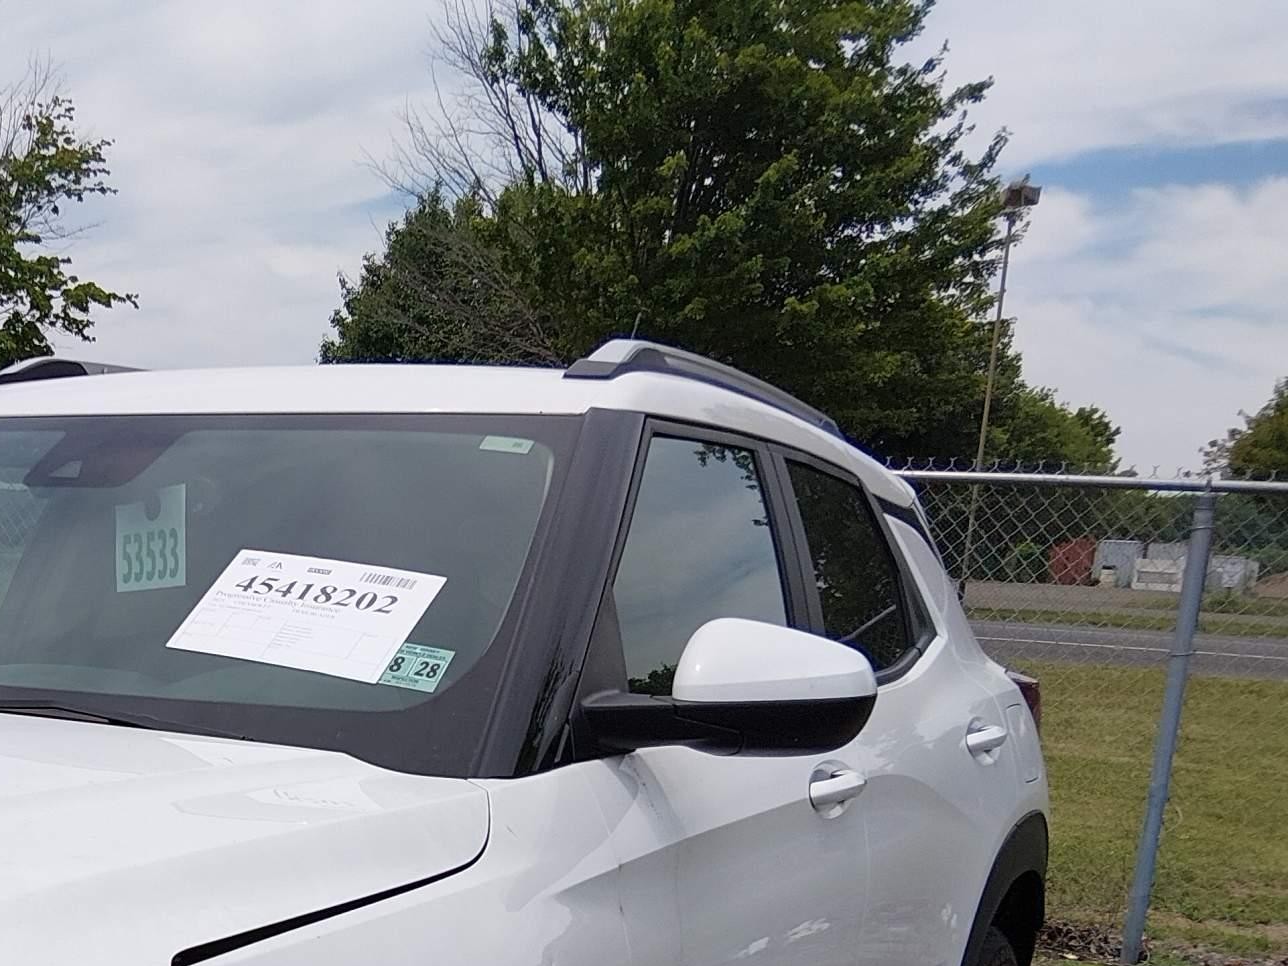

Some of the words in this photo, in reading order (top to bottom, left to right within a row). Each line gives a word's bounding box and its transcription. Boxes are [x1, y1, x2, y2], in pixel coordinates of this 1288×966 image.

[123, 528, 179, 584] 53533
[235, 575, 399, 614] 45418202
[389, 656, 405, 672] 8
[414, 661, 440, 678] 28
